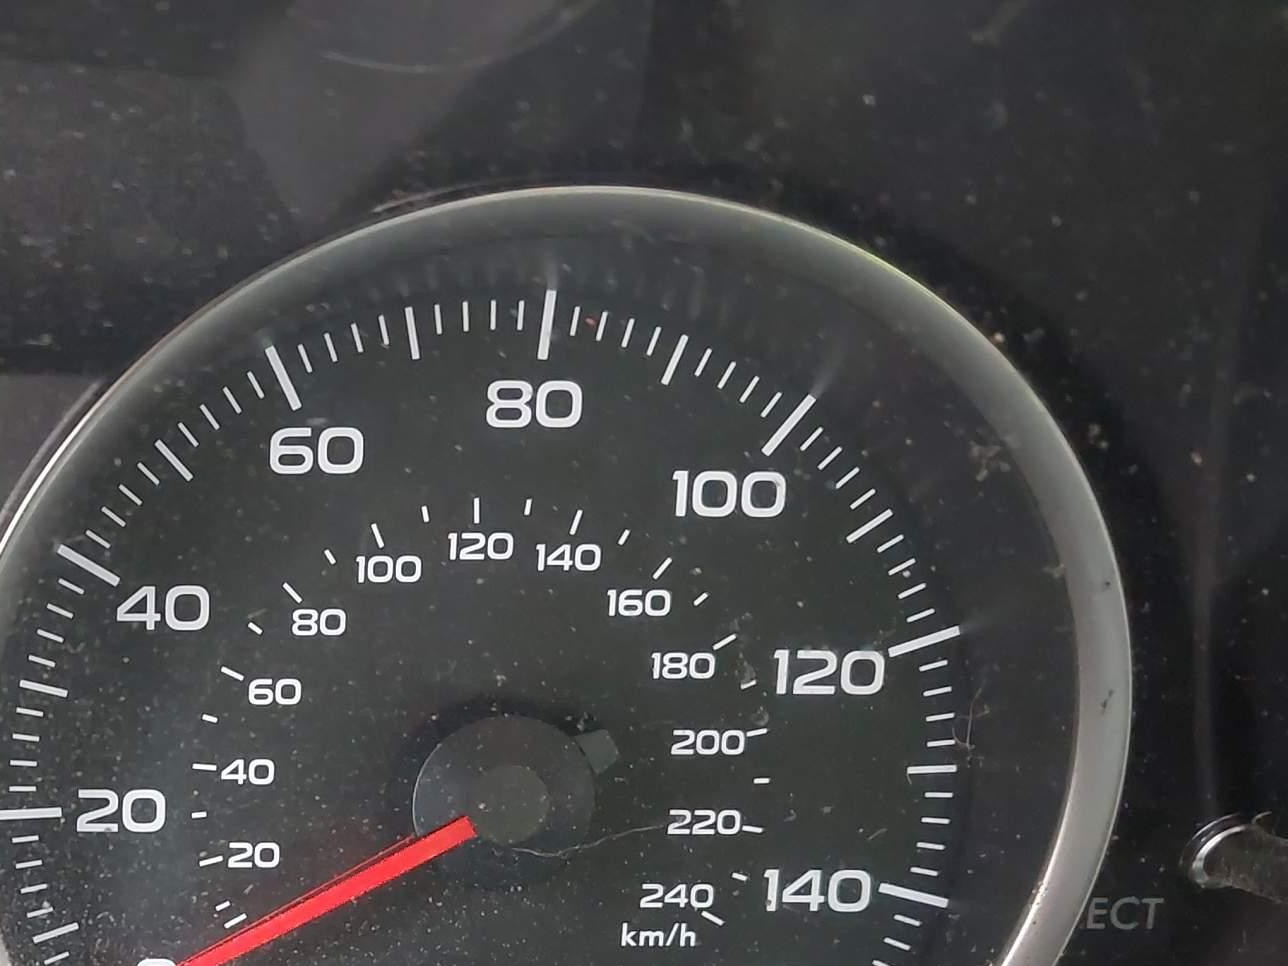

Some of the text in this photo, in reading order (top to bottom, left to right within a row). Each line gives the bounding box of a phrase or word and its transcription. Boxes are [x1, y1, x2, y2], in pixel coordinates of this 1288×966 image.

[485, 380, 582, 428] 80
[269, 428, 364, 474] 60
[672, 470, 786, 517] 100
[448, 532, 513, 560] 120
[536, 543, 601, 571] 140
[356, 556, 421, 583] 100
[117, 585, 210, 630] 40
[607, 588, 671, 616] 160
[292, 609, 346, 636] 80
[651, 652, 715, 678] 180
[774, 649, 885, 695] 120
[249, 678, 301, 705] 60
[671, 730, 745, 755] 200
[221, 759, 275, 785] 40
[77, 789, 166, 833] 20
[667, 809, 741, 835] 220
[228, 842, 279, 868] 20
[640, 884, 714, 908] 240
[764, 869, 871, 912] 140
[621, 923, 696, 947] km/h
